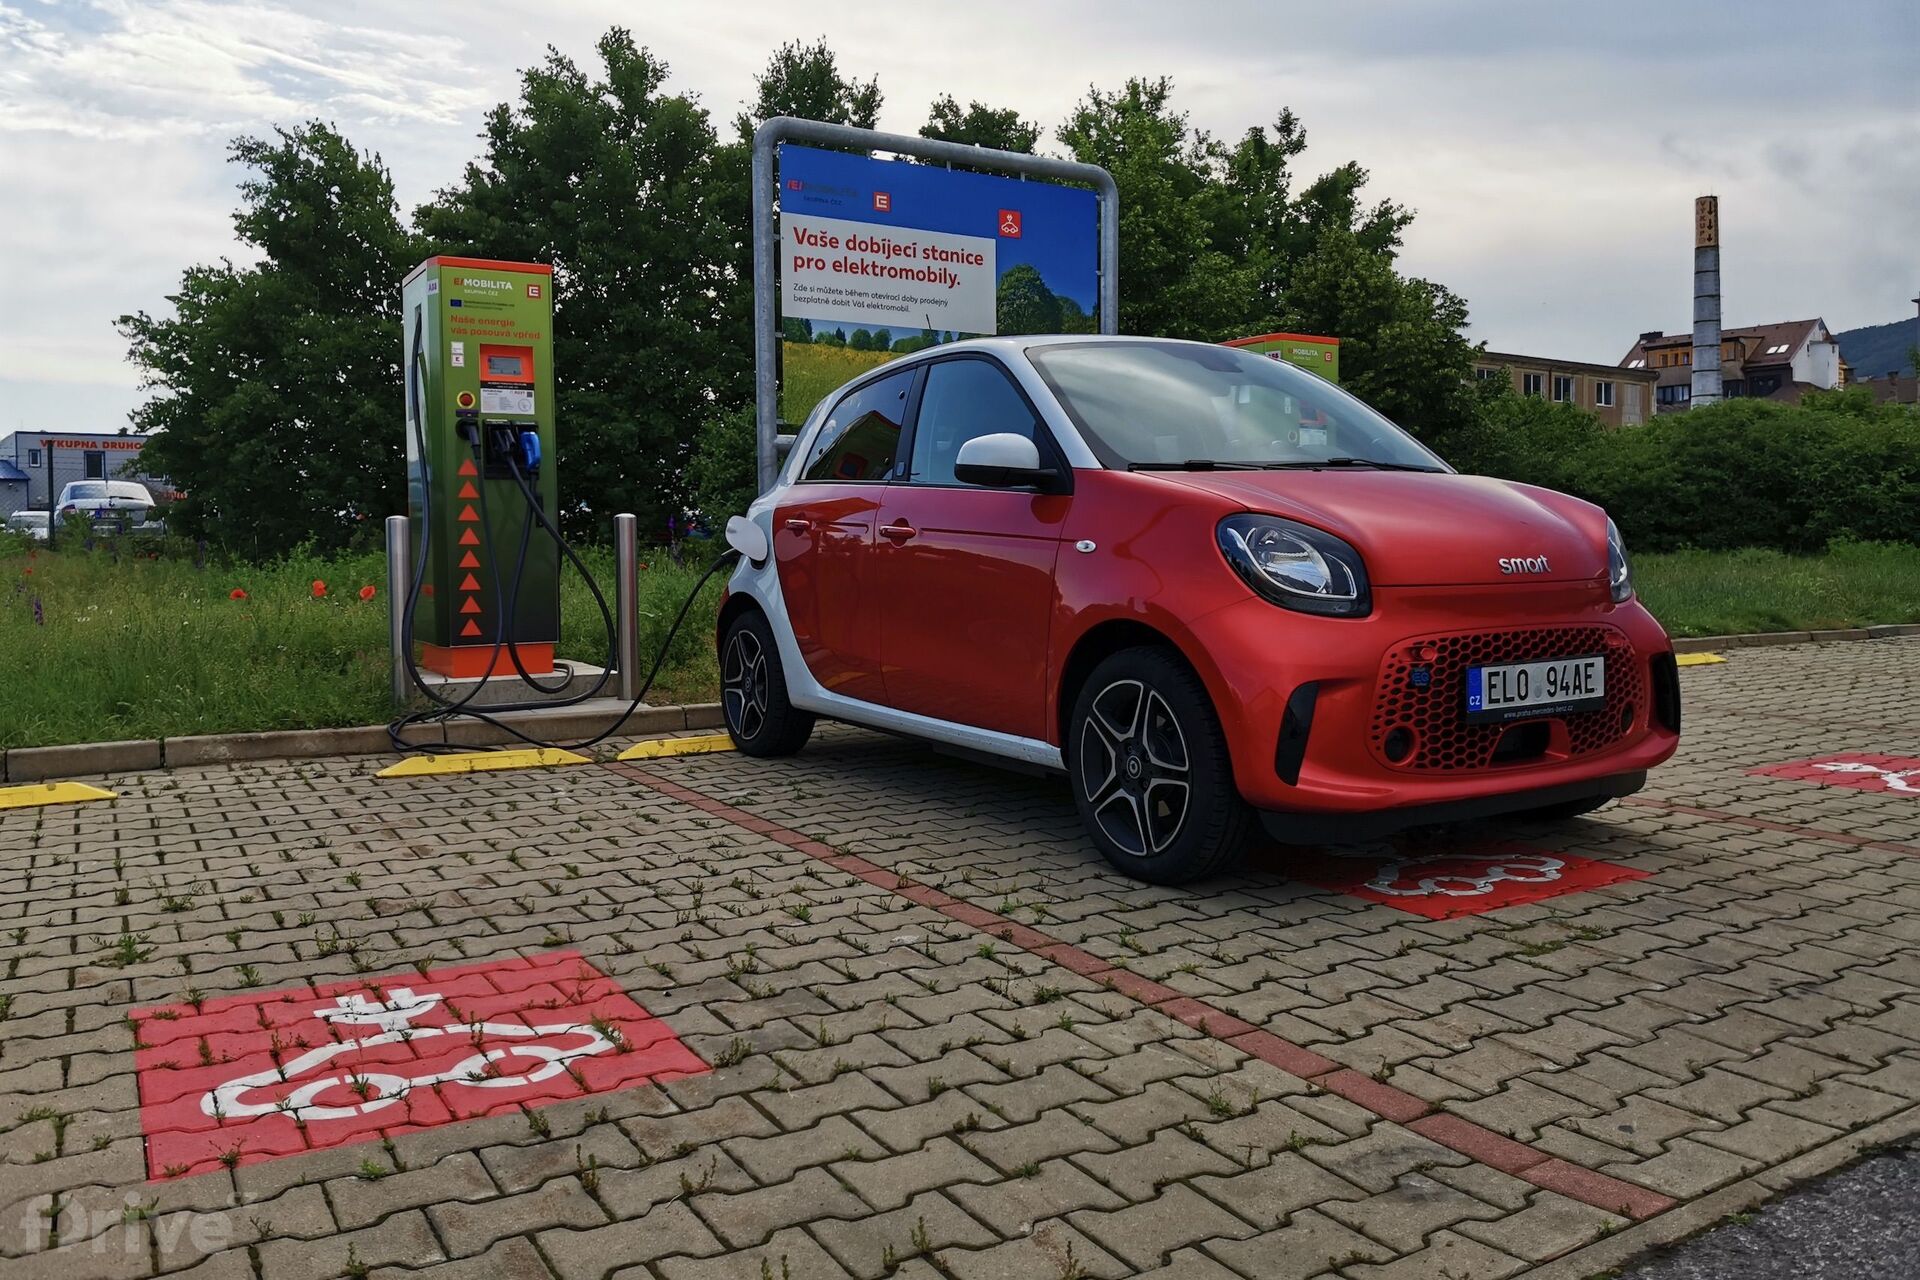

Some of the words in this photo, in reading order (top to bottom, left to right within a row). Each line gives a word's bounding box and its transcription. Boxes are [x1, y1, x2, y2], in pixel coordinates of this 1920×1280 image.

[793, 226, 839, 249] Vaše
[845, 234, 917, 260] dobíjecí
[922, 245, 984, 266] stanice
[793, 255, 826, 273] pro
[832, 256, 961, 289] elektromobily.
[793, 283, 808, 292] Zde
[816, 286, 844, 296] můžete
[845, 288, 870, 298] během
[901, 294, 919, 304] doby
[919, 297, 949, 307] prodejny
[793, 293, 830, 305] bezplatně
[450, 315, 476, 325] Naše
[478, 318, 515, 328] energie
[102, 439, 144, 451] DRUHO
[1498, 554, 1552, 574] smart
[1546, 662, 1595, 698] 94AE
[1469, 695, 1481, 706] CZ
